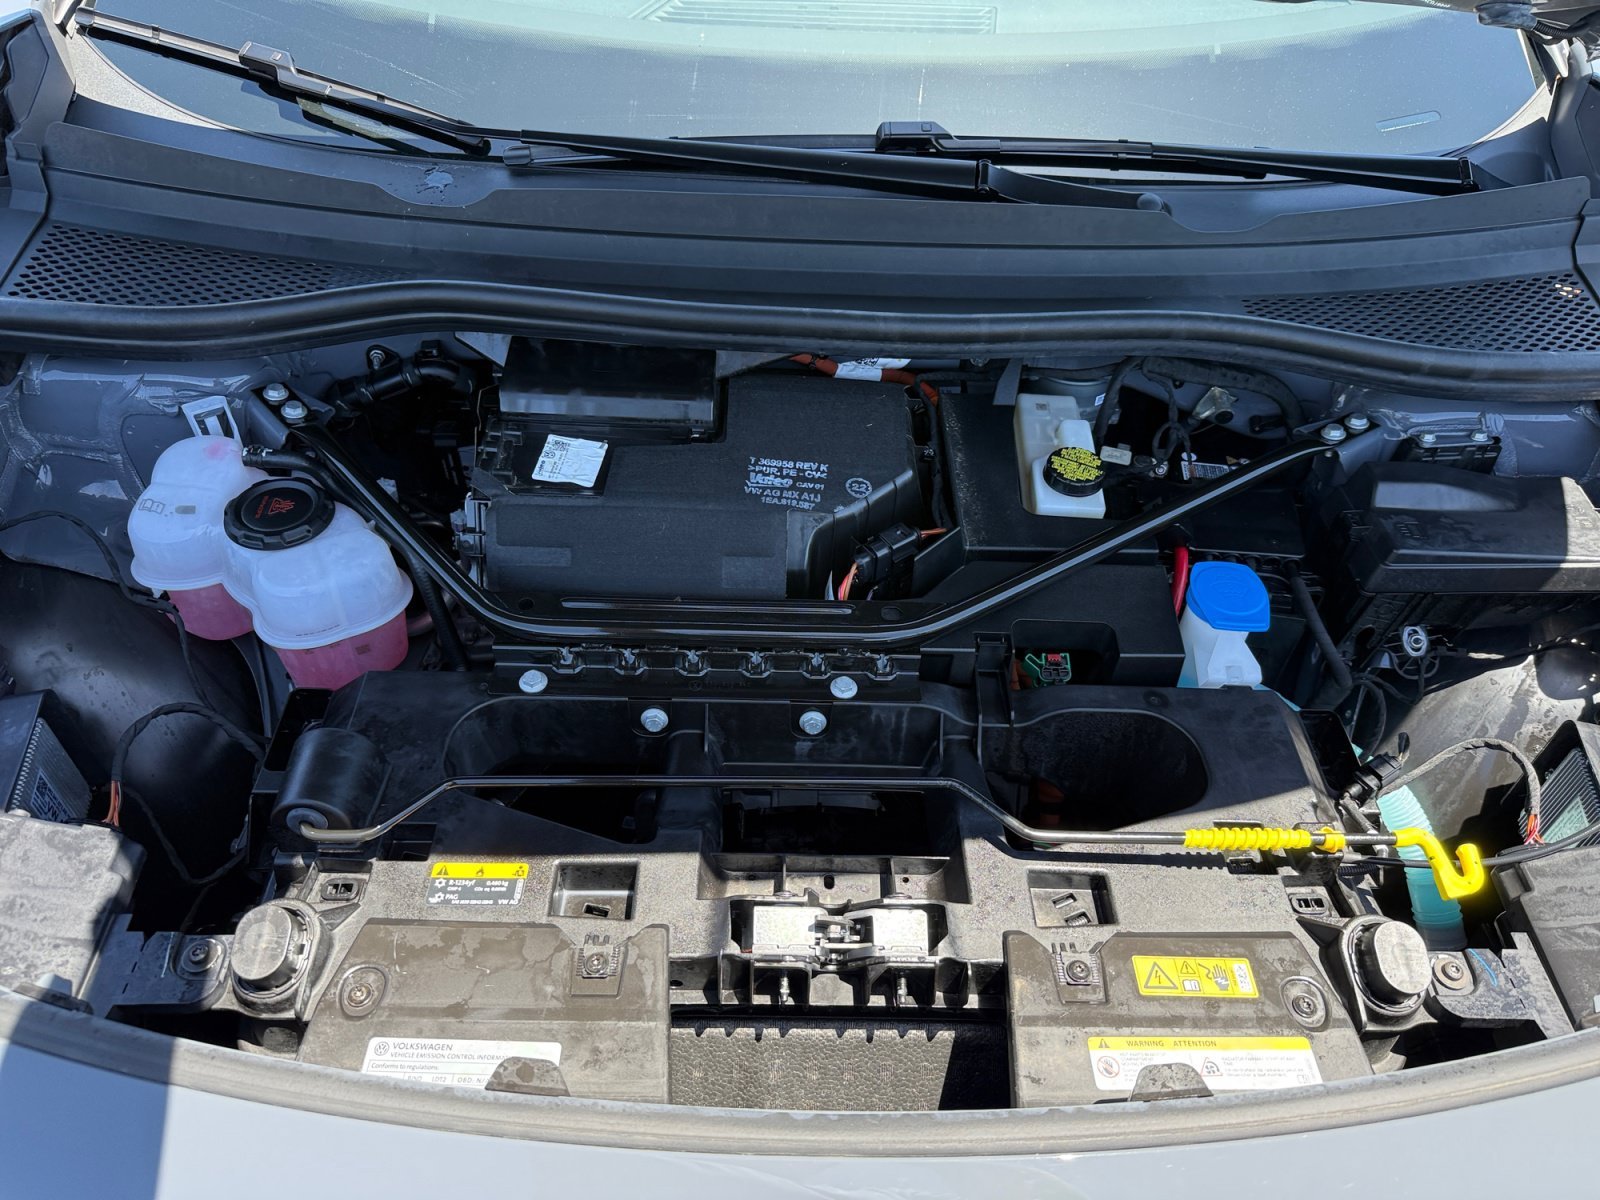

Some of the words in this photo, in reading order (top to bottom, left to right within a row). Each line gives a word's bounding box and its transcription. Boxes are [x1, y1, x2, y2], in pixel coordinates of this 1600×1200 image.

[758, 458, 795, 469] 369958
[795, 461, 819, 471] REV
[819, 463, 830, 472] K
[782, 468, 799, 477] PE
[763, 488, 781, 498] AG
[448, 879, 476, 888] R-1234yf
[392, 1042, 454, 1051] VOLKSWAGEN
[1126, 1040, 1165, 1048] WARNING
[1173, 1040, 1217, 1048] ATTENTION
[415, 1052, 446, 1060] EMISSION
[446, 1053, 475, 1061] CONTROL
